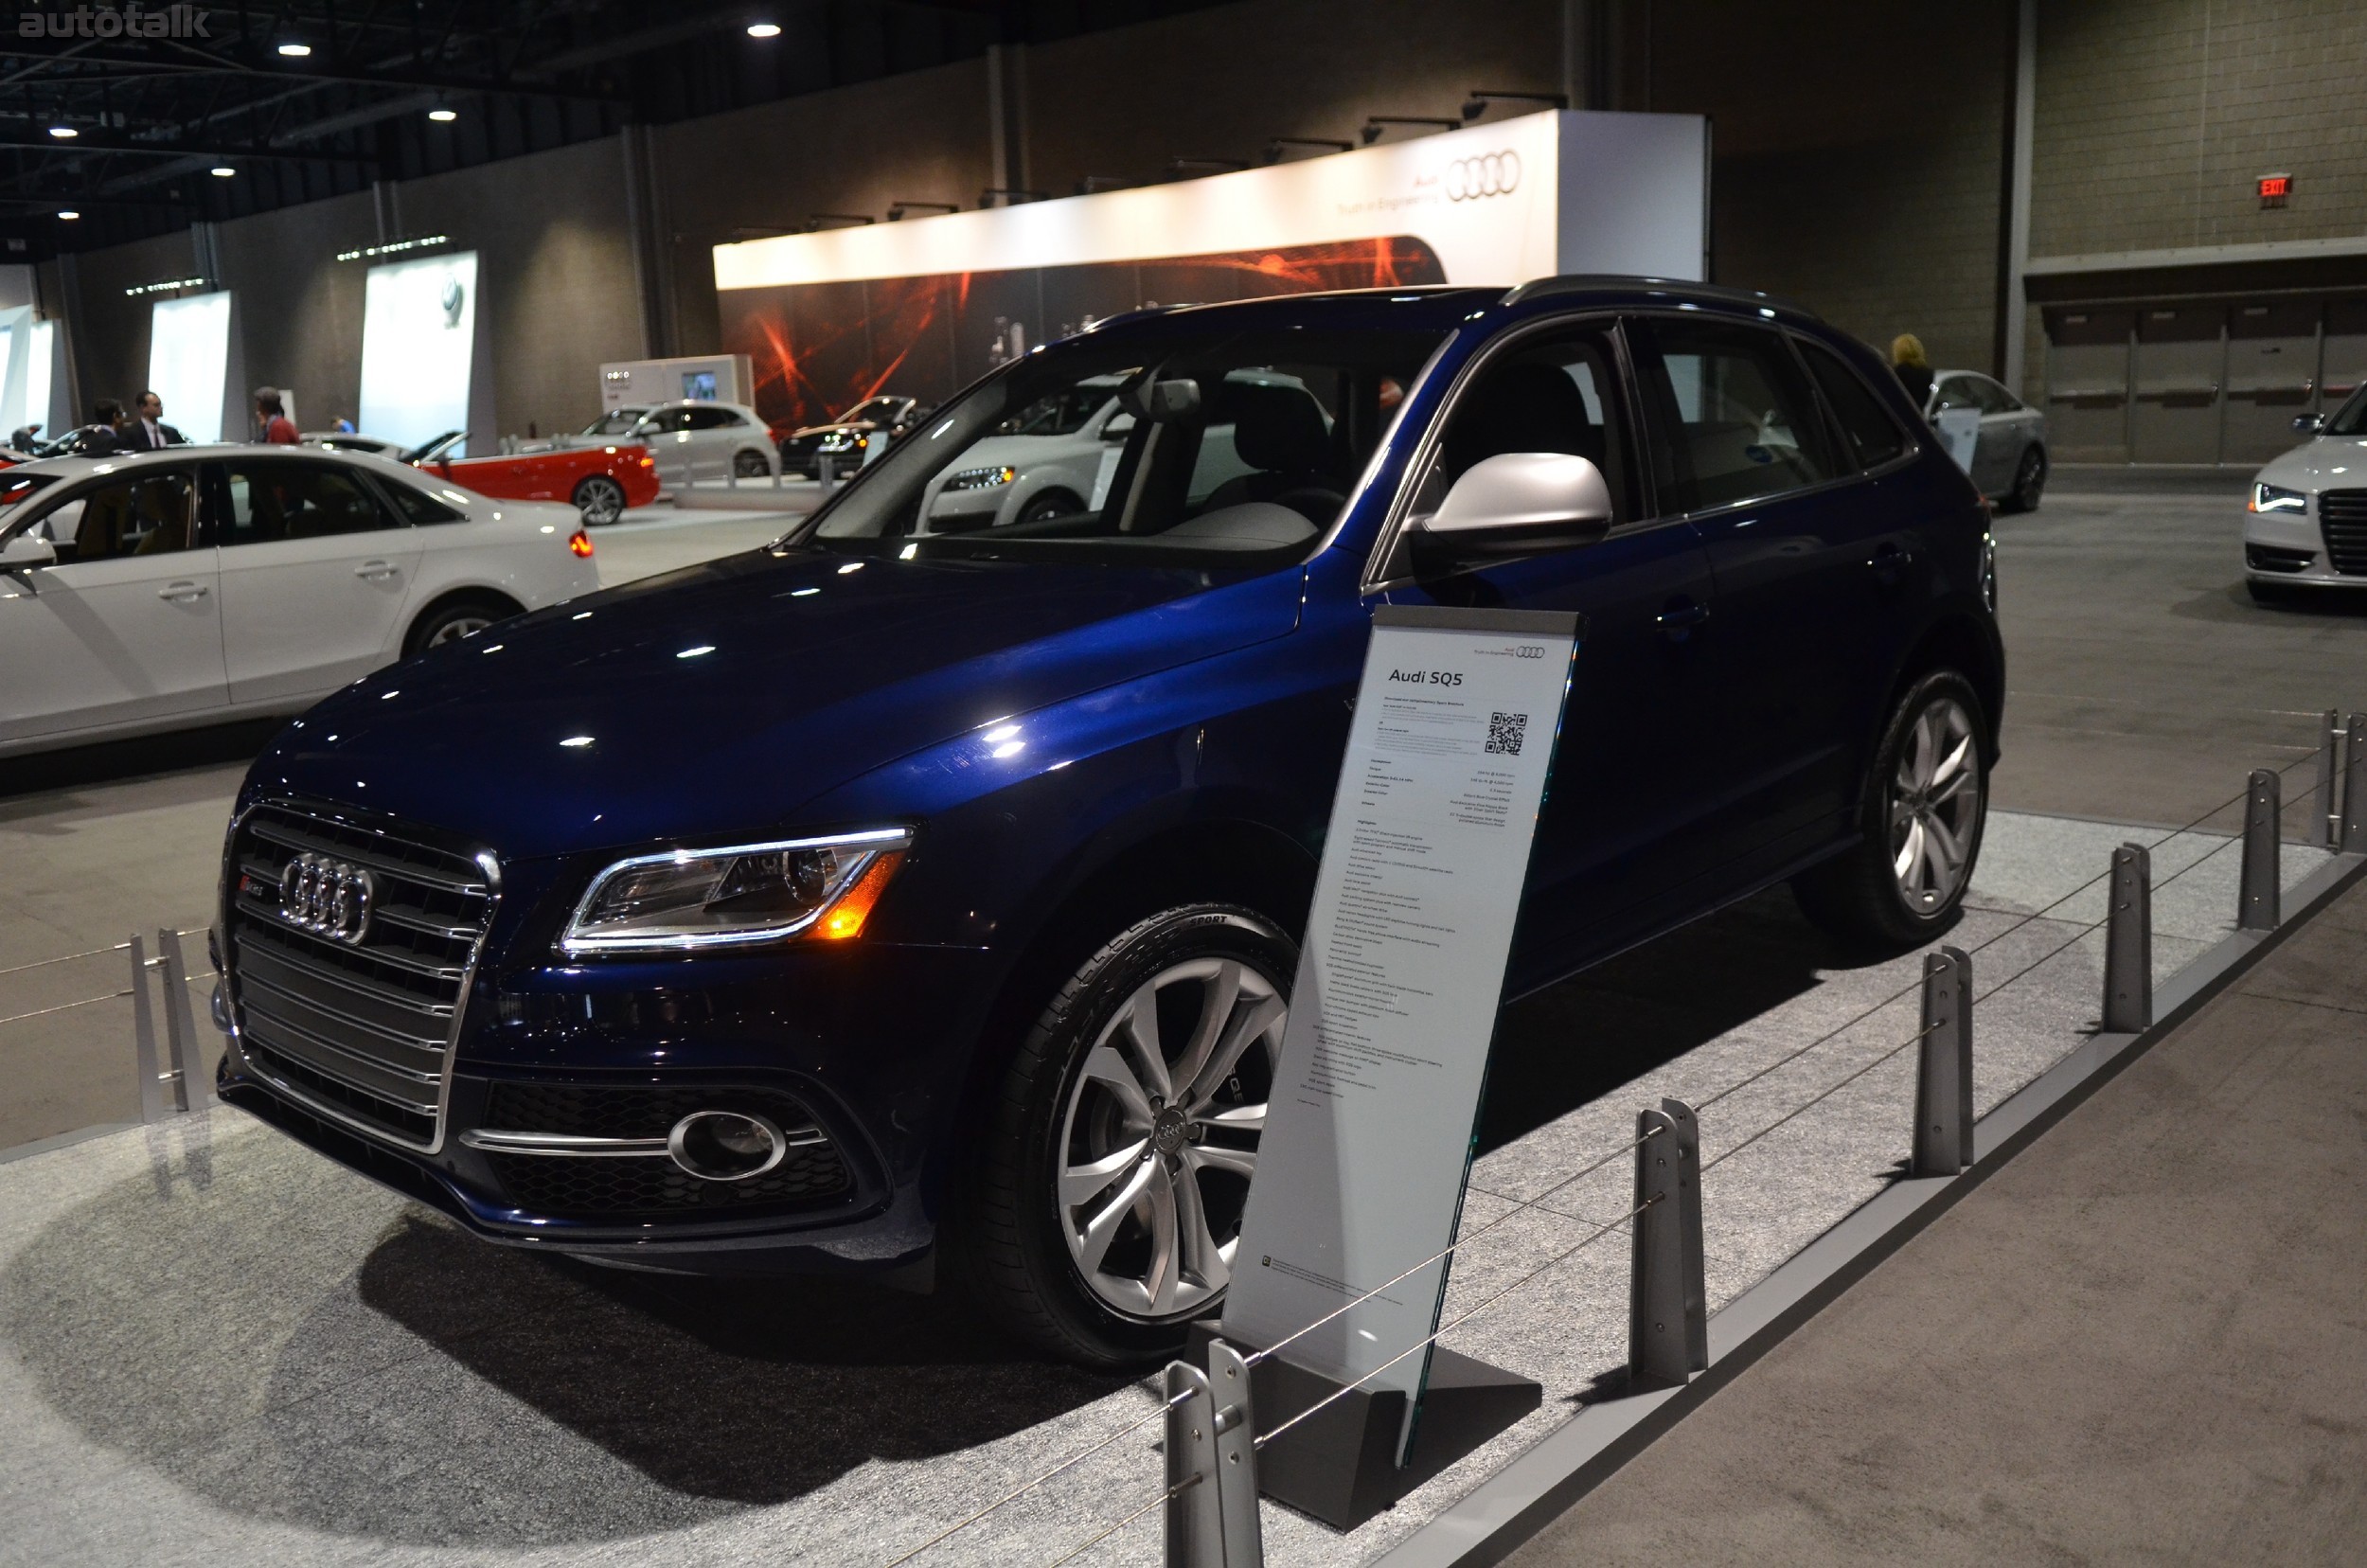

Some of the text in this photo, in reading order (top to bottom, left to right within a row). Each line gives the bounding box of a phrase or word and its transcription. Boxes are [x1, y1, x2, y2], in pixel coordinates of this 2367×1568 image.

[1388, 668, 1464, 687] Audi SQ5
[1189, 915, 1228, 926] SPORT
